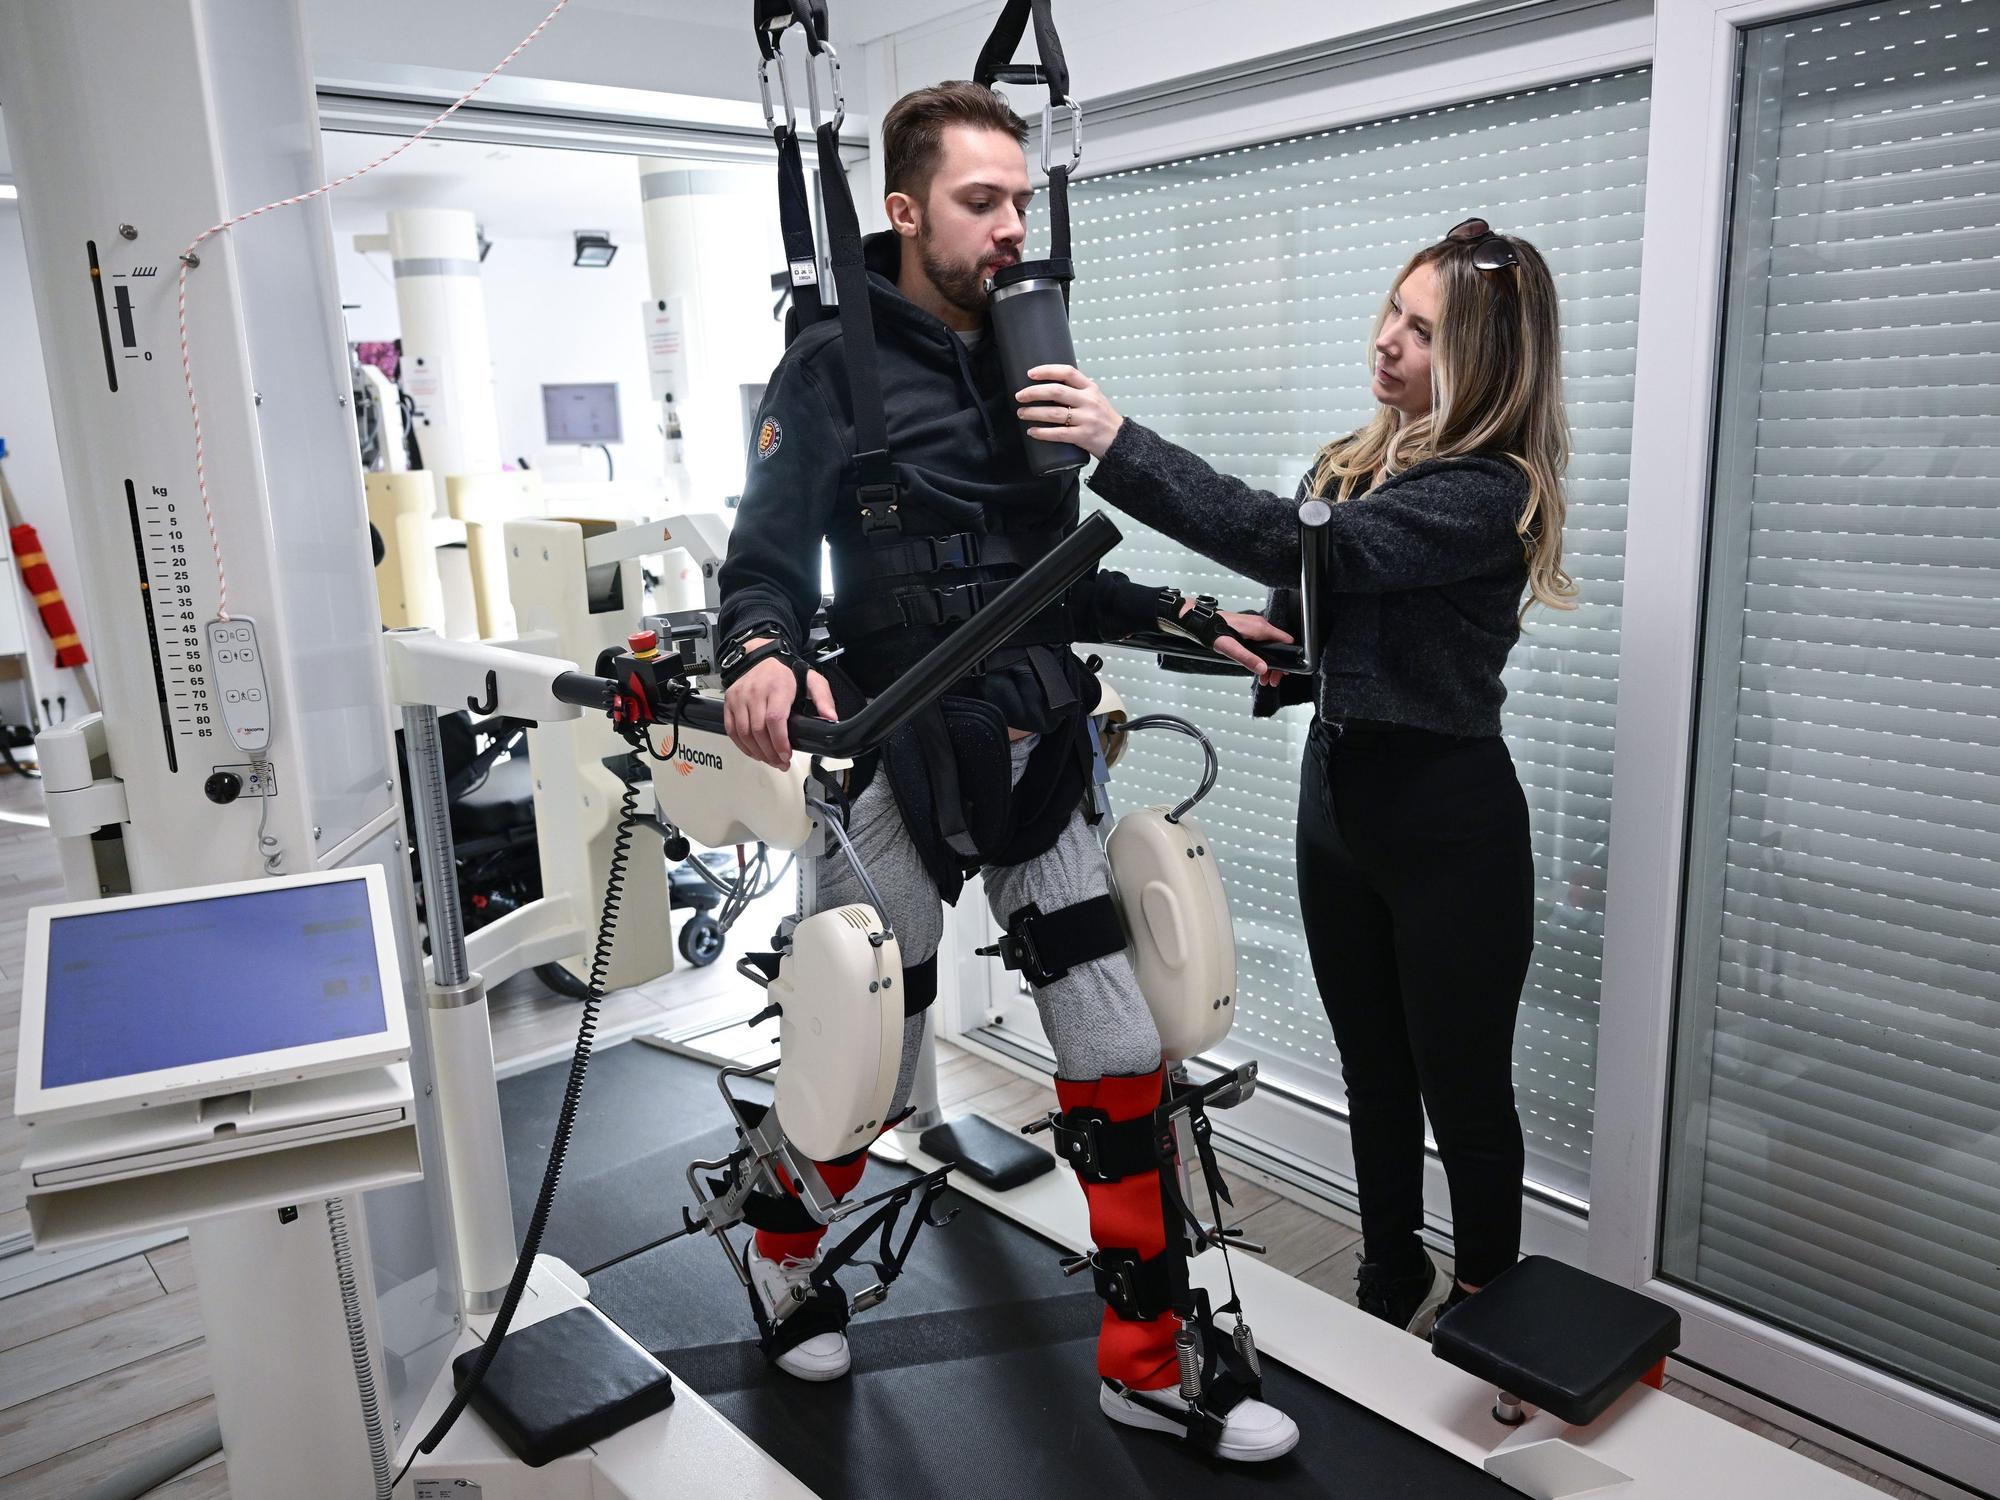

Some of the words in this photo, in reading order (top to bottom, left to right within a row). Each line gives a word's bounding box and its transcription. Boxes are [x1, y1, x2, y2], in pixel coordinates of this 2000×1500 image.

[144, 351, 153, 361] 0
[152, 485, 168, 497] kg
[167, 503, 176, 513] 0
[170, 517, 178, 527] 5
[168, 530, 183, 540] 10
[170, 544, 185, 554] 15
[172, 557, 187, 567] 20
[174, 571, 189, 581] 25
[176, 584, 191, 594] 30
[178, 598, 193, 607] 35
[180, 611, 195, 620] 40
[182, 624, 197, 634] 45
[184, 637, 199, 647] 50
[186, 650, 201, 660] 55
[188, 663, 203, 673] 60
[190, 677, 205, 686] 65
[191, 689, 207, 699] 70
[193, 702, 209, 712] 75
[196, 715, 211, 725] 80
[198, 728, 213, 738] 85
[678, 743, 723, 770] Hocoma
